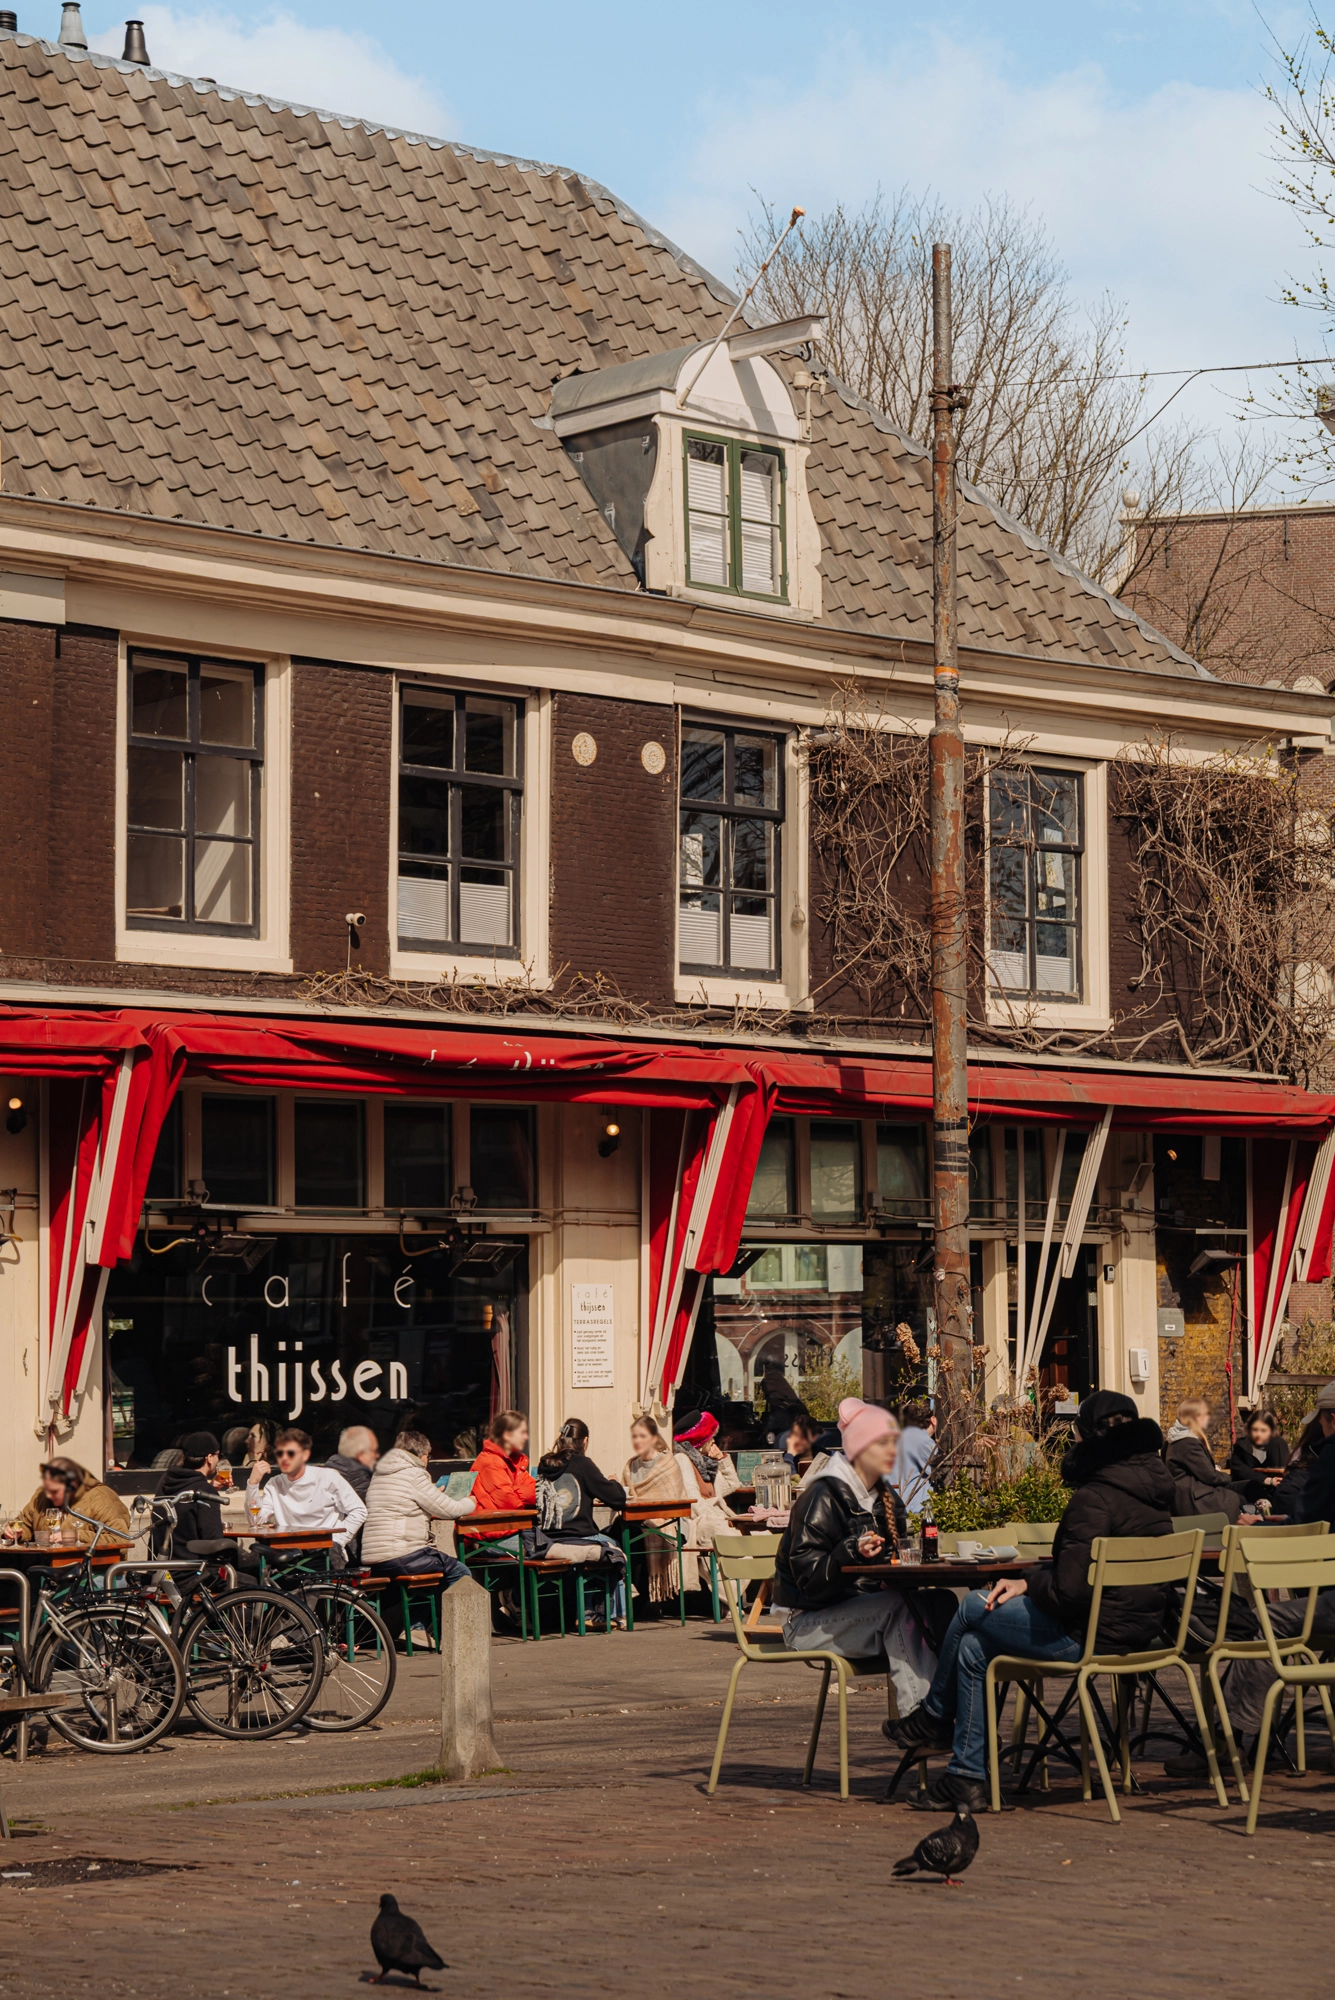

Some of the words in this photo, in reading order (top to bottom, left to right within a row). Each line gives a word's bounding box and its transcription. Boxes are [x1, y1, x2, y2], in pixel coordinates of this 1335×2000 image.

[202, 1252, 415, 1309] café
[580, 1301, 606, 1314] thijssen
[228, 1334, 408, 1421] thijssen
